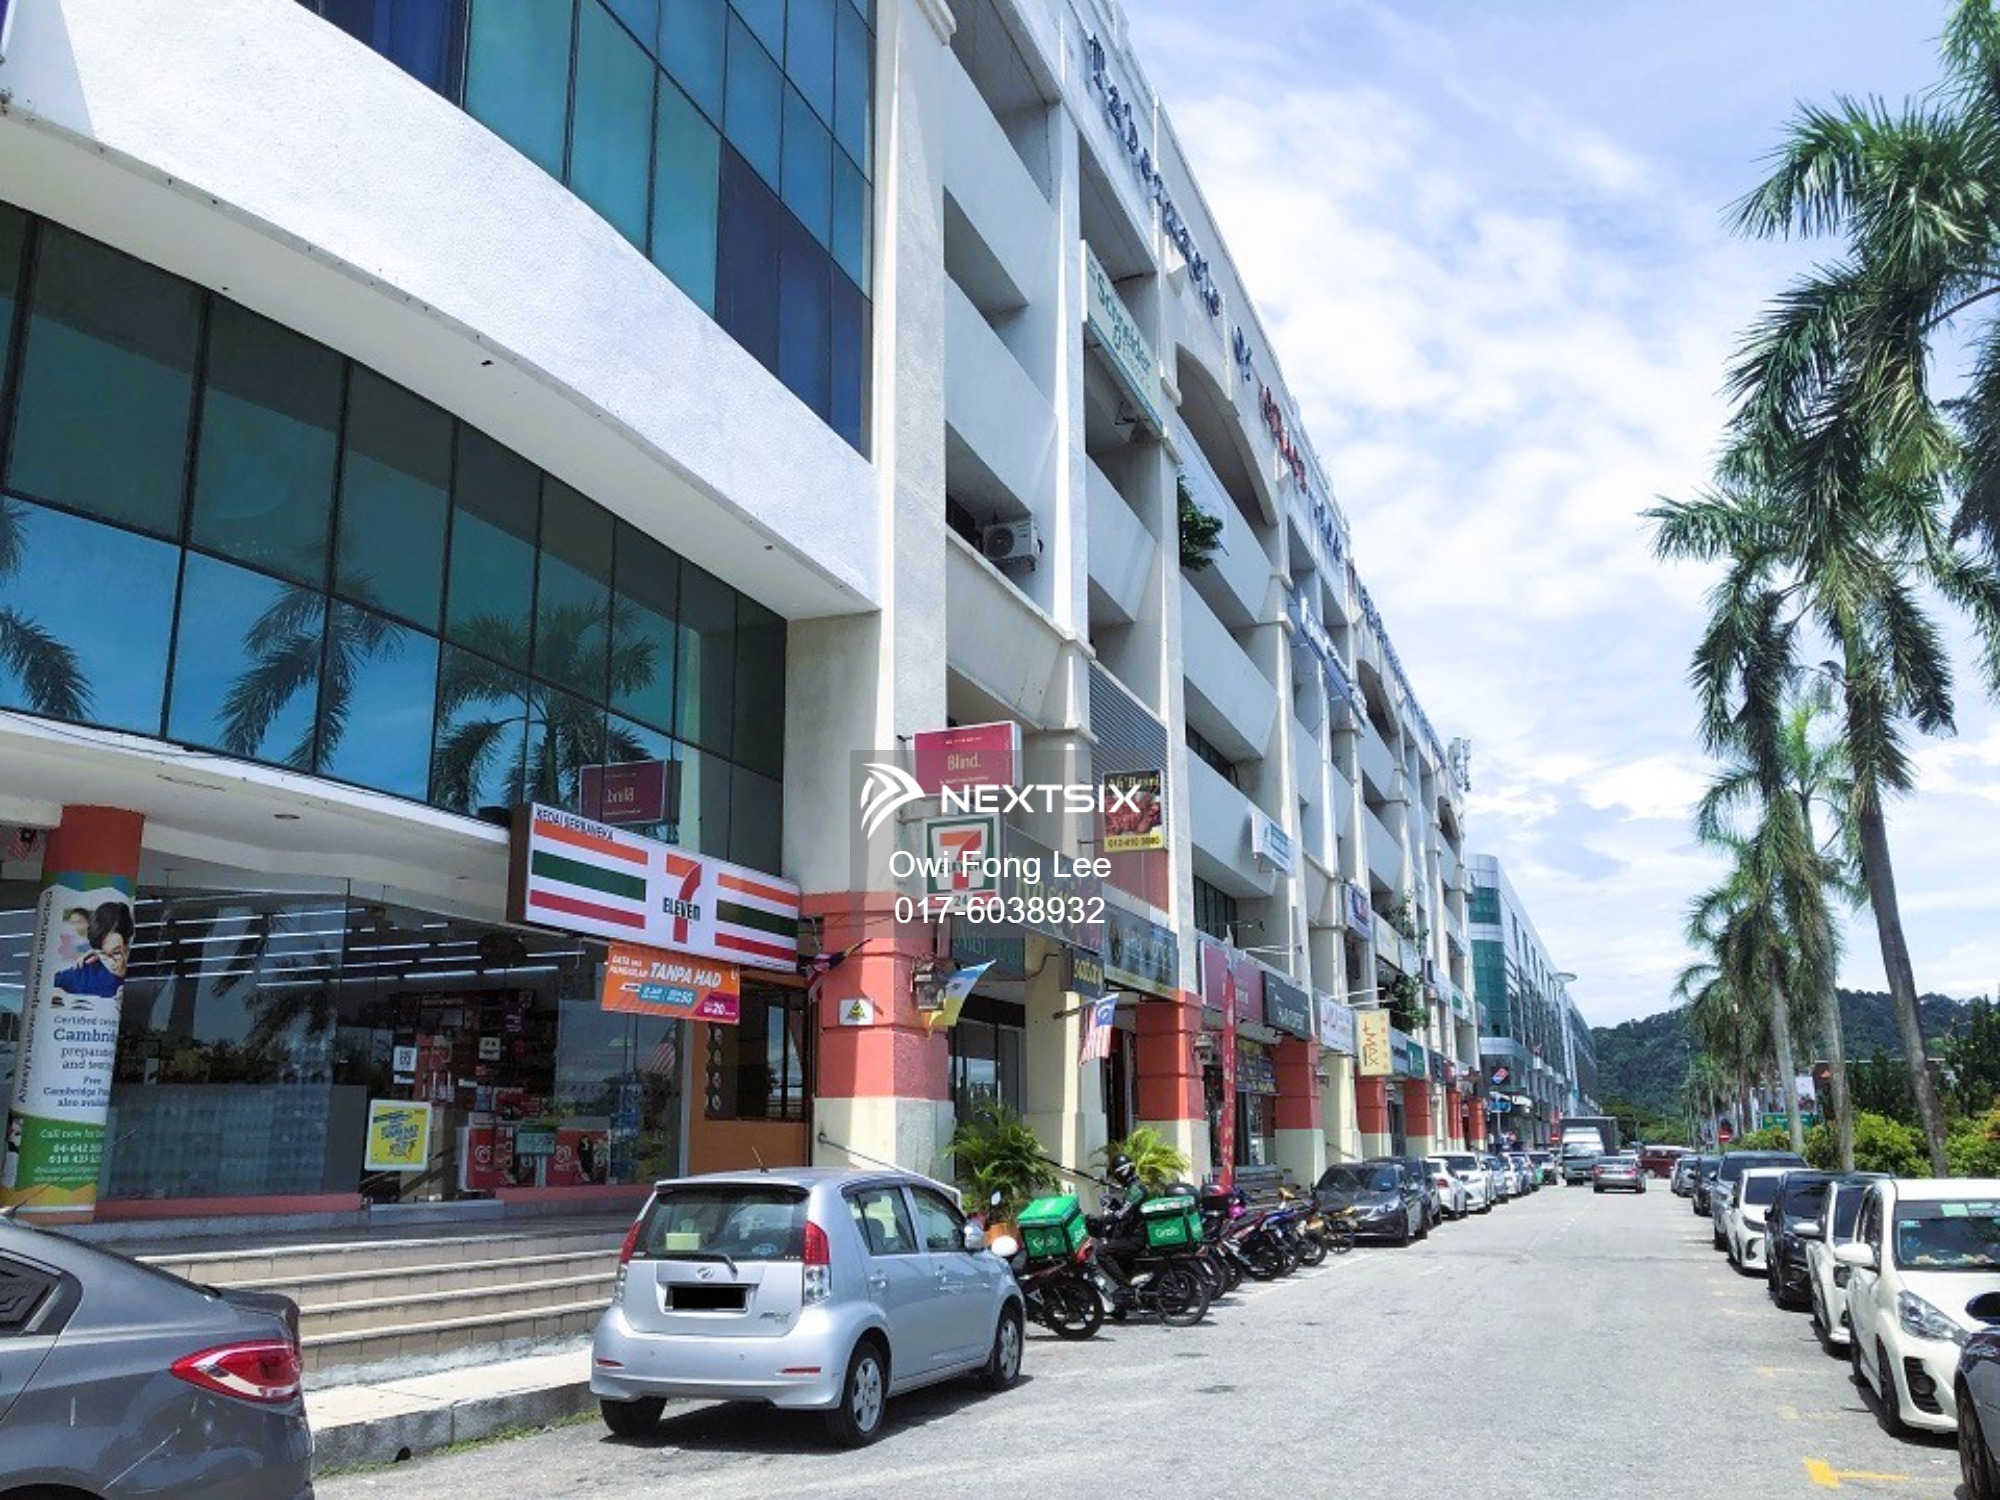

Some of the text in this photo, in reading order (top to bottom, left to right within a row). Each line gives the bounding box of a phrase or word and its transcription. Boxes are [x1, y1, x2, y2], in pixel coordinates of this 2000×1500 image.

[666, 853, 702, 944] 7
[650, 961, 693, 984] TANPA
[693, 969, 721, 988] HAD
[1156, 1227, 1179, 1238] Grab
